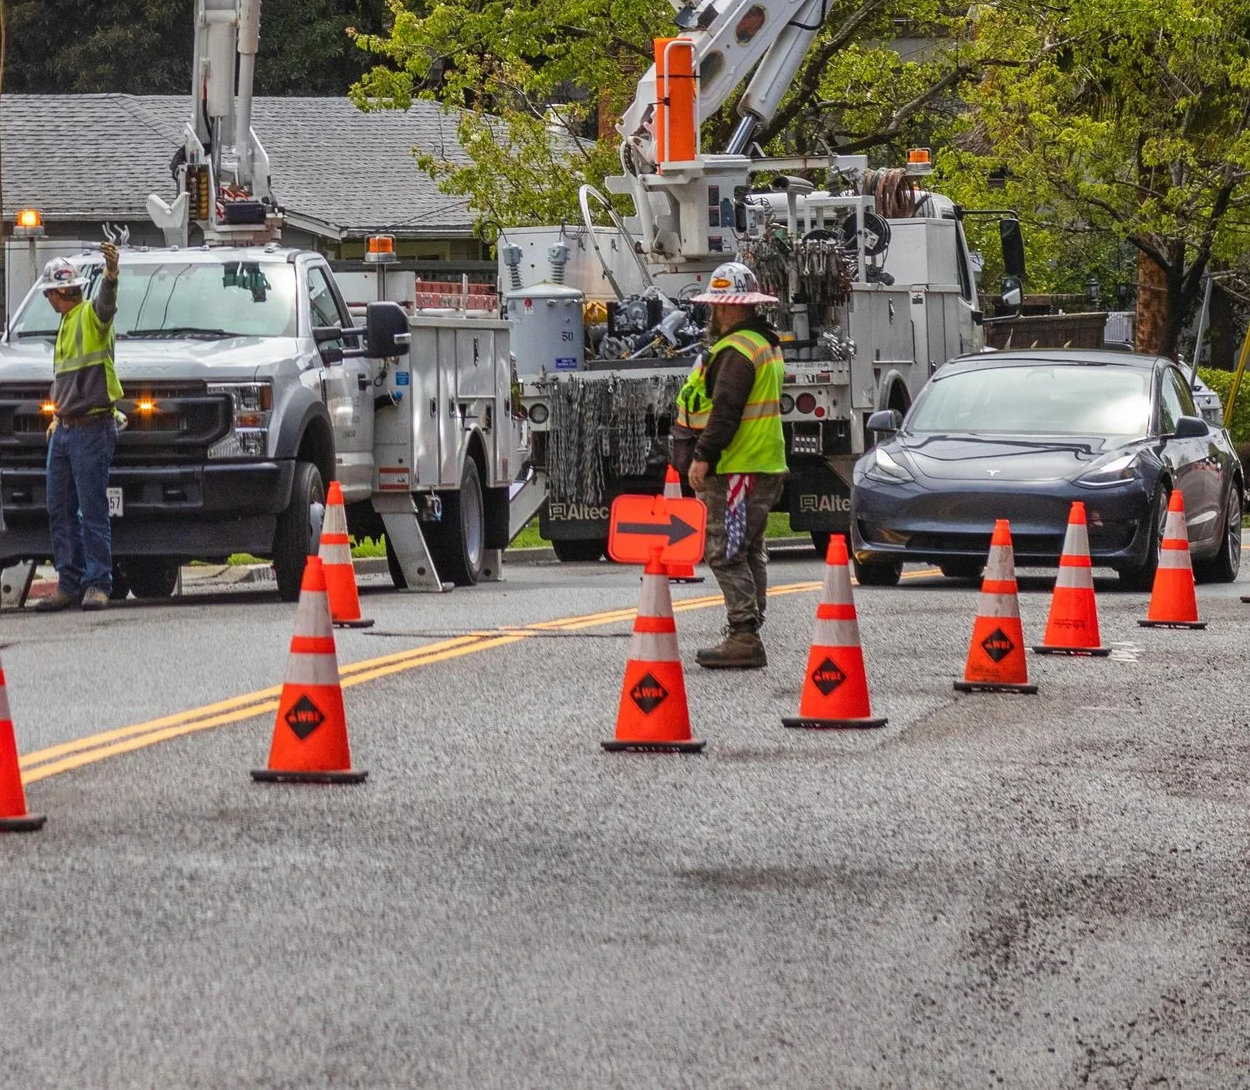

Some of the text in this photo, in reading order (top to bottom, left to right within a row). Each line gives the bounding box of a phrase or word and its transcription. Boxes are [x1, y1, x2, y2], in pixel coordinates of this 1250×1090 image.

[561, 331, 574, 342] 50
[567, 502, 610, 520] Altec
[819, 495, 851, 511] Alte
